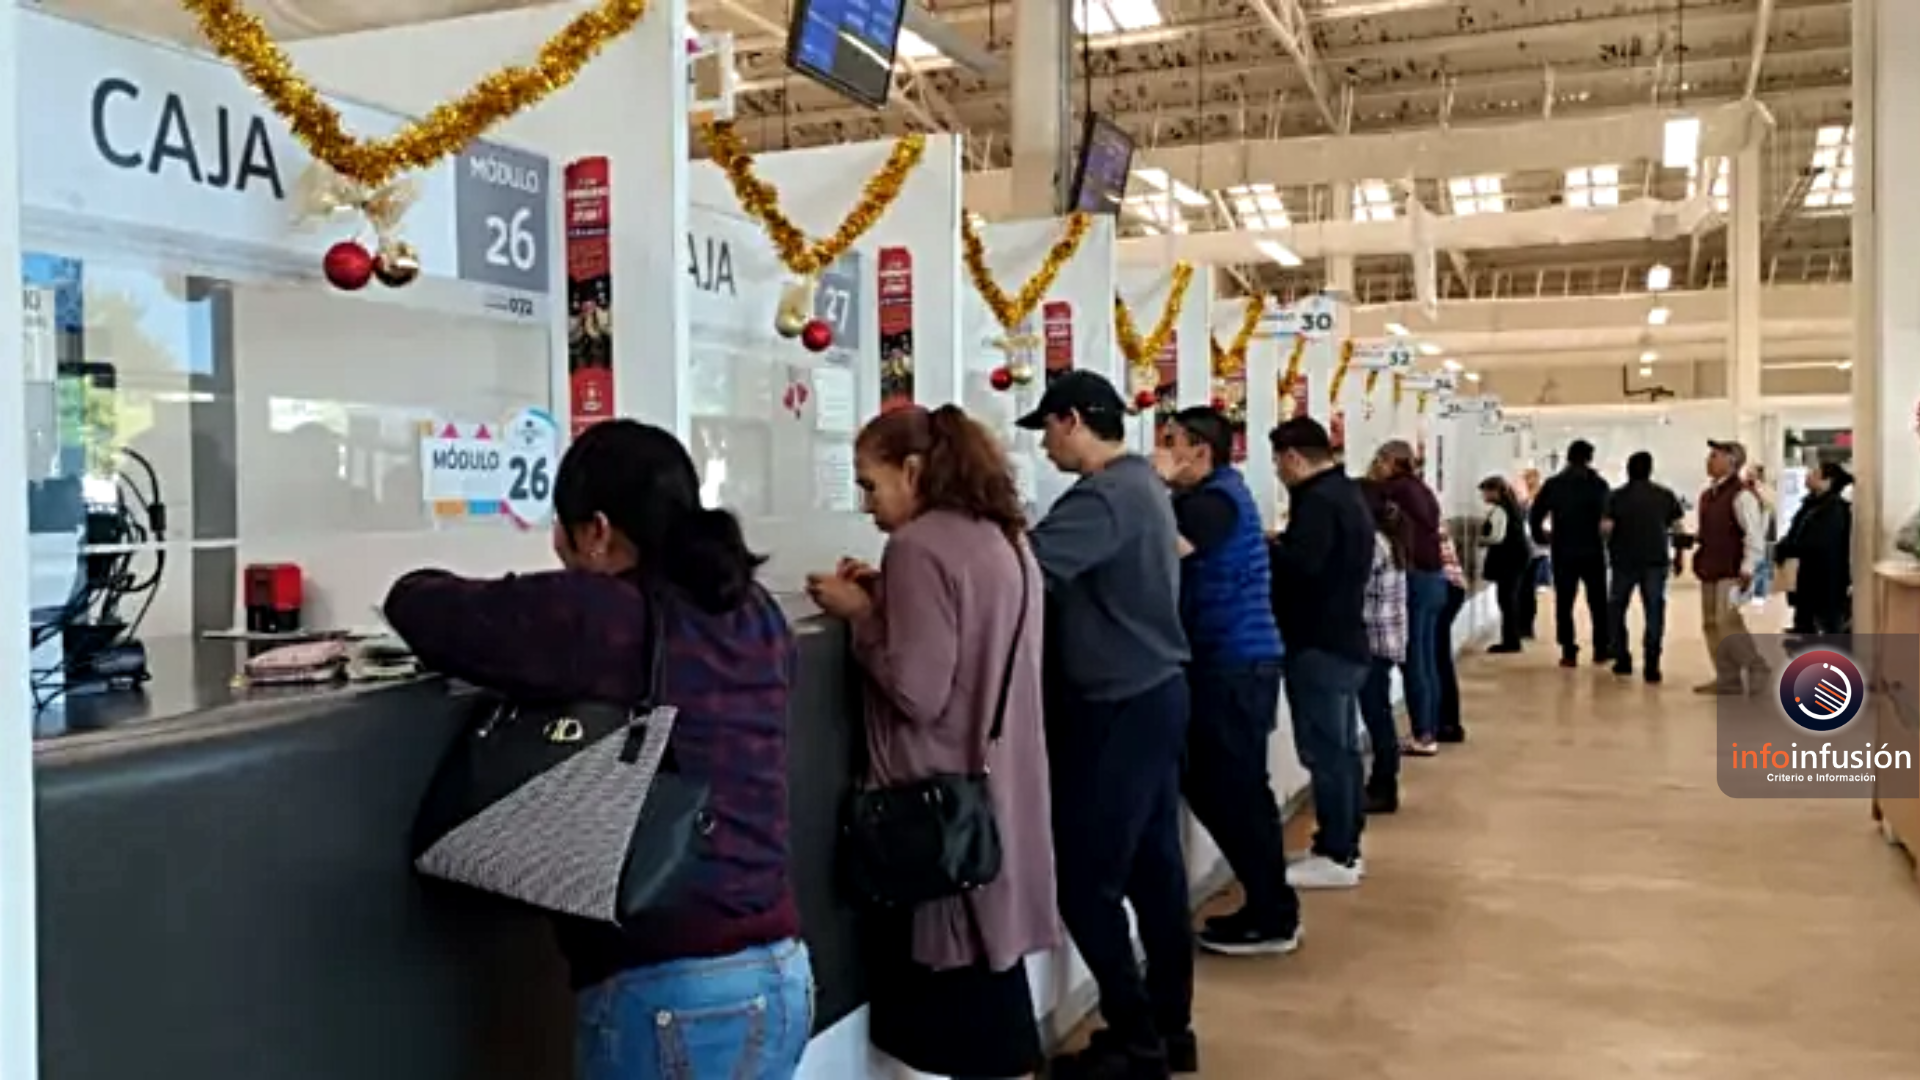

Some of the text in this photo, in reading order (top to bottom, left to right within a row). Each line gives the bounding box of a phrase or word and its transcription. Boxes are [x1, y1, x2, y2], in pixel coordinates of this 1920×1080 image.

[92, 77, 285, 200] CAJA
[469, 154, 540, 193] MÓDULO
[485, 206, 536, 271] 26
[825, 285, 850, 335] 27
[1301, 312, 1333, 331] 30
[1388, 351, 1410, 367] 32
[433, 442, 550, 501] MÓDULO 26
